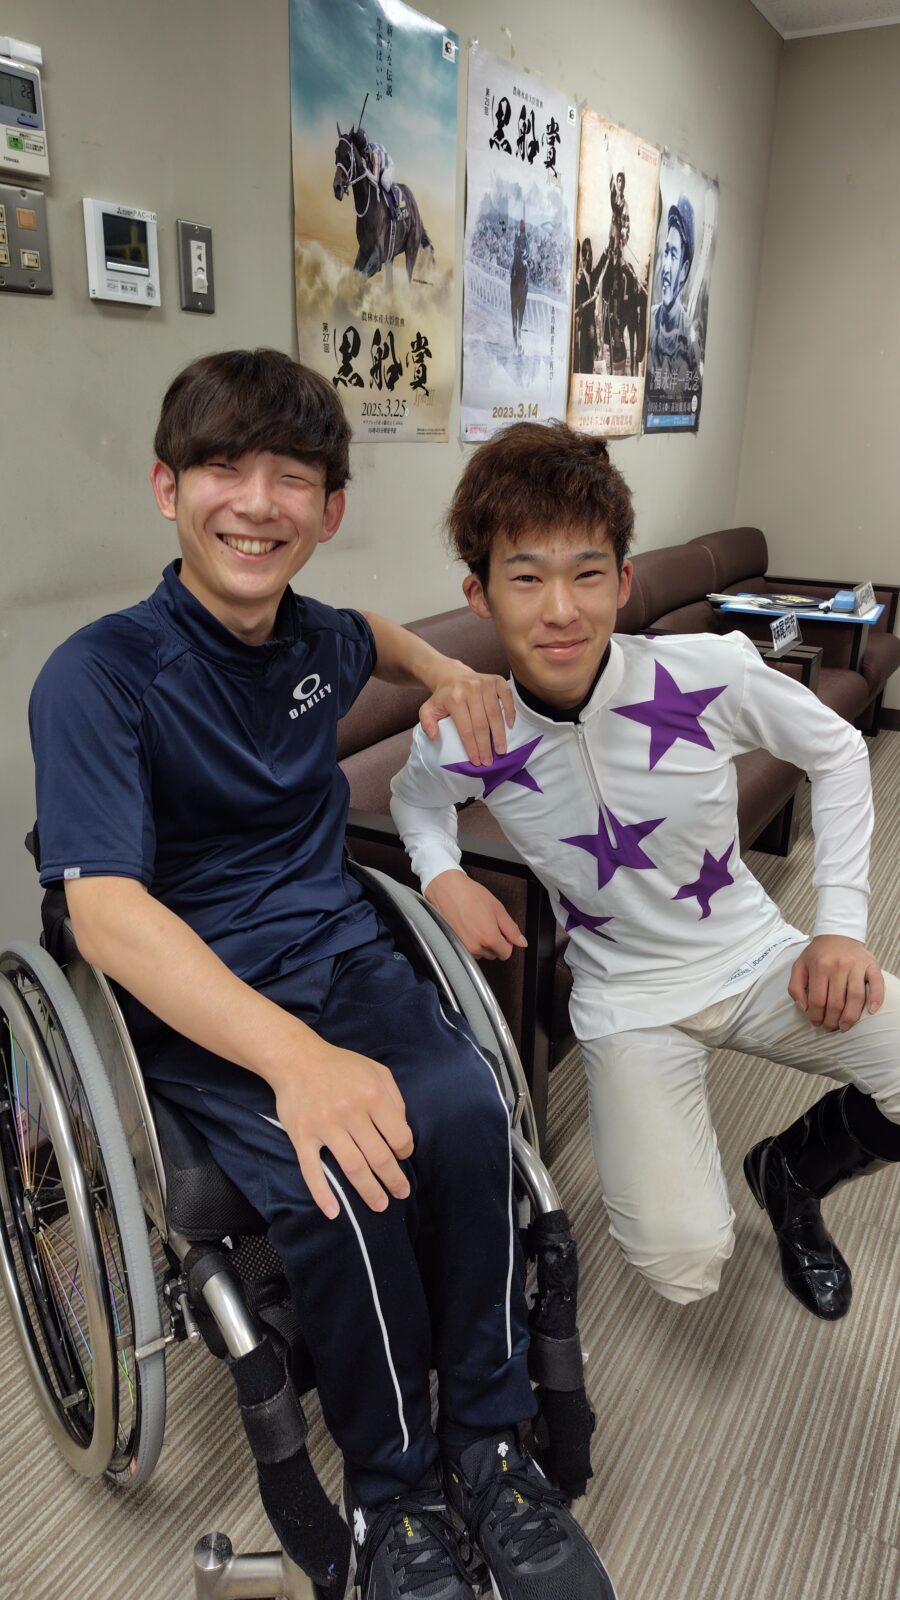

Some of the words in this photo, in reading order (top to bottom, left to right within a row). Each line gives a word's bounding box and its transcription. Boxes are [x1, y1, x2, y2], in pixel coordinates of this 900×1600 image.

[489, 96, 561, 179] 黒船賞
[322, 322, 330, 354] 第27回
[332, 325, 433, 397] 黒船賞
[361, 398, 407, 418] 2025.3.25
[584, 381, 638, 405] 福永洋一記念
[492, 403, 539, 419] 2023.3.14
[288, 683, 332, 720] OAKLEY
